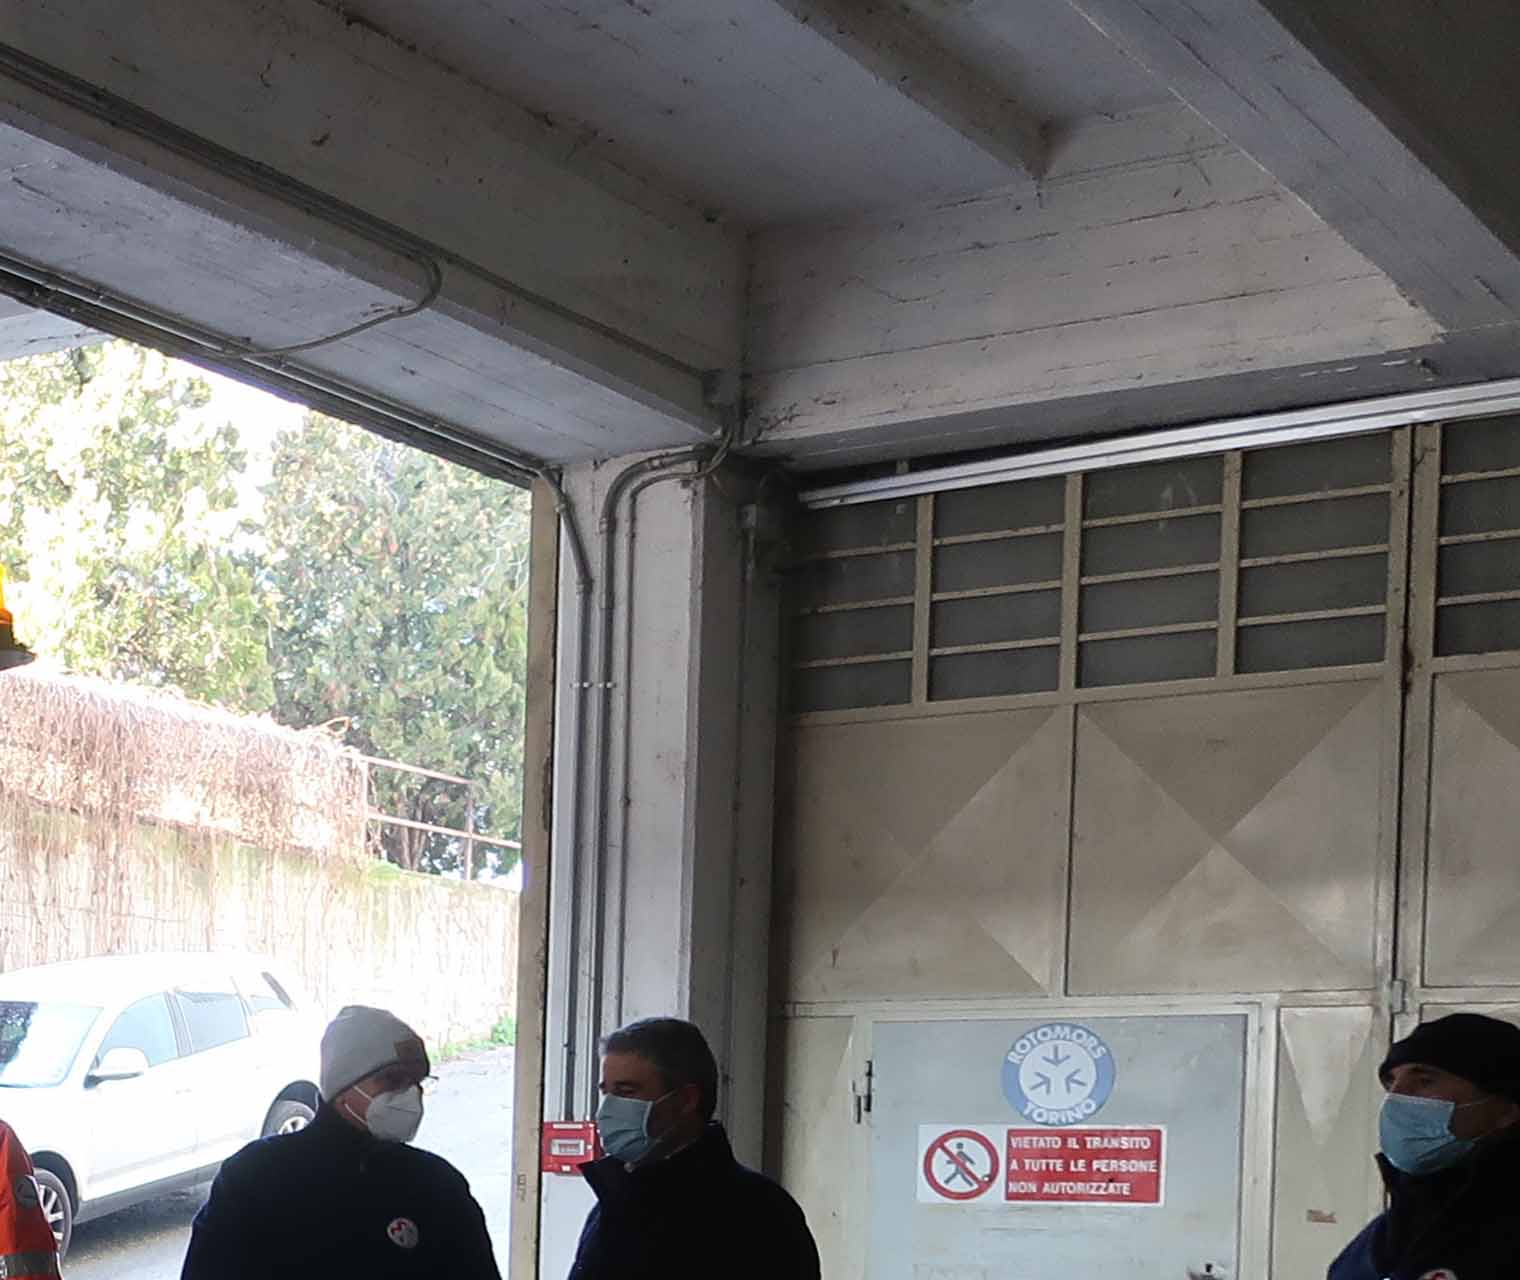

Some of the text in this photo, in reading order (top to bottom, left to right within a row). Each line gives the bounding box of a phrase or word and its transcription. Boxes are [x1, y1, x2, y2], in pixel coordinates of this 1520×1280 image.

[1008, 1026, 1106, 1064] ROTOMORS
[1024, 1099, 1096, 1124] TORINO
[1011, 1136, 1151, 1150] VIETATO IL TRANSITO
[1010, 1160, 1158, 1172] A TUTTE LE PERSONE
[1009, 1182, 1131, 1195] NON AUTORIZZATE
